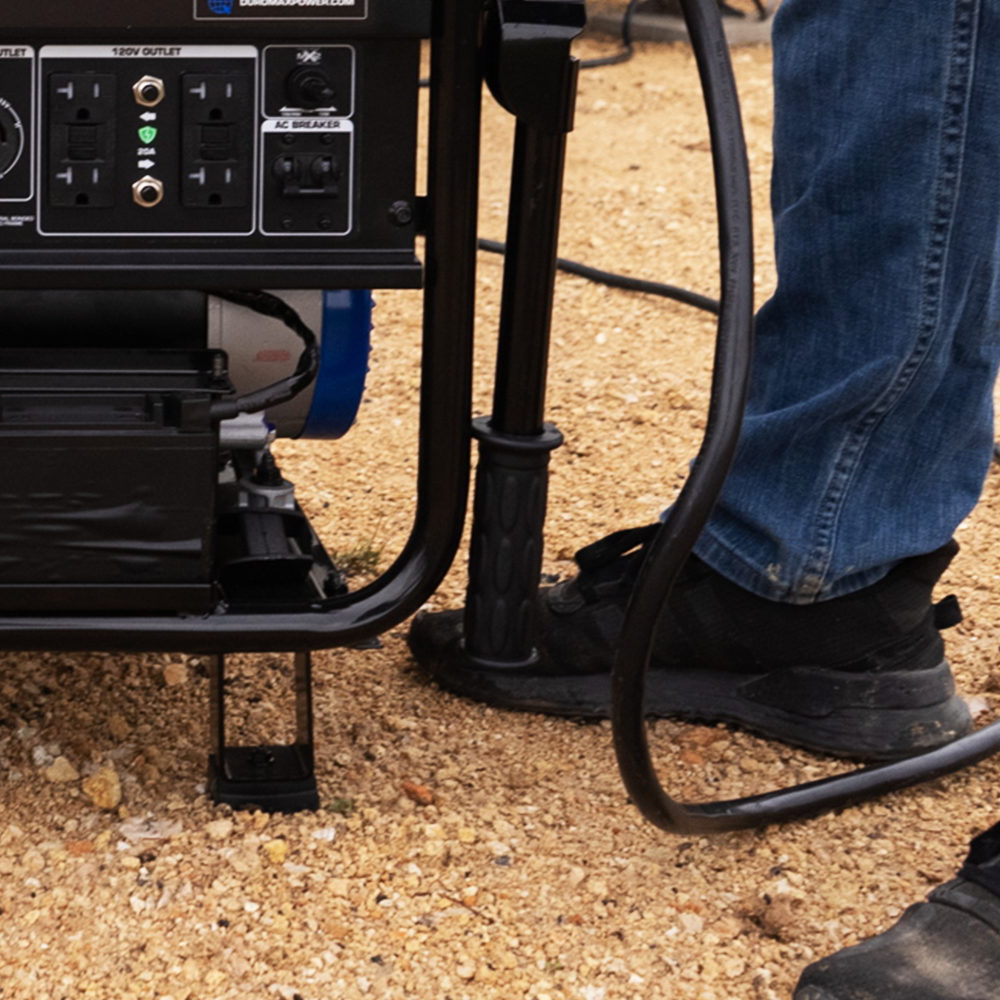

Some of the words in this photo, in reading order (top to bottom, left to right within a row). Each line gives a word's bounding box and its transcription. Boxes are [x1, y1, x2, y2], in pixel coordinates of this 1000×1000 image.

[112, 46, 140, 57] 120V
[141, 46, 182, 57] OUTLET
[275, 120, 290, 130] AC
[292, 120, 341, 130] BREAKER
